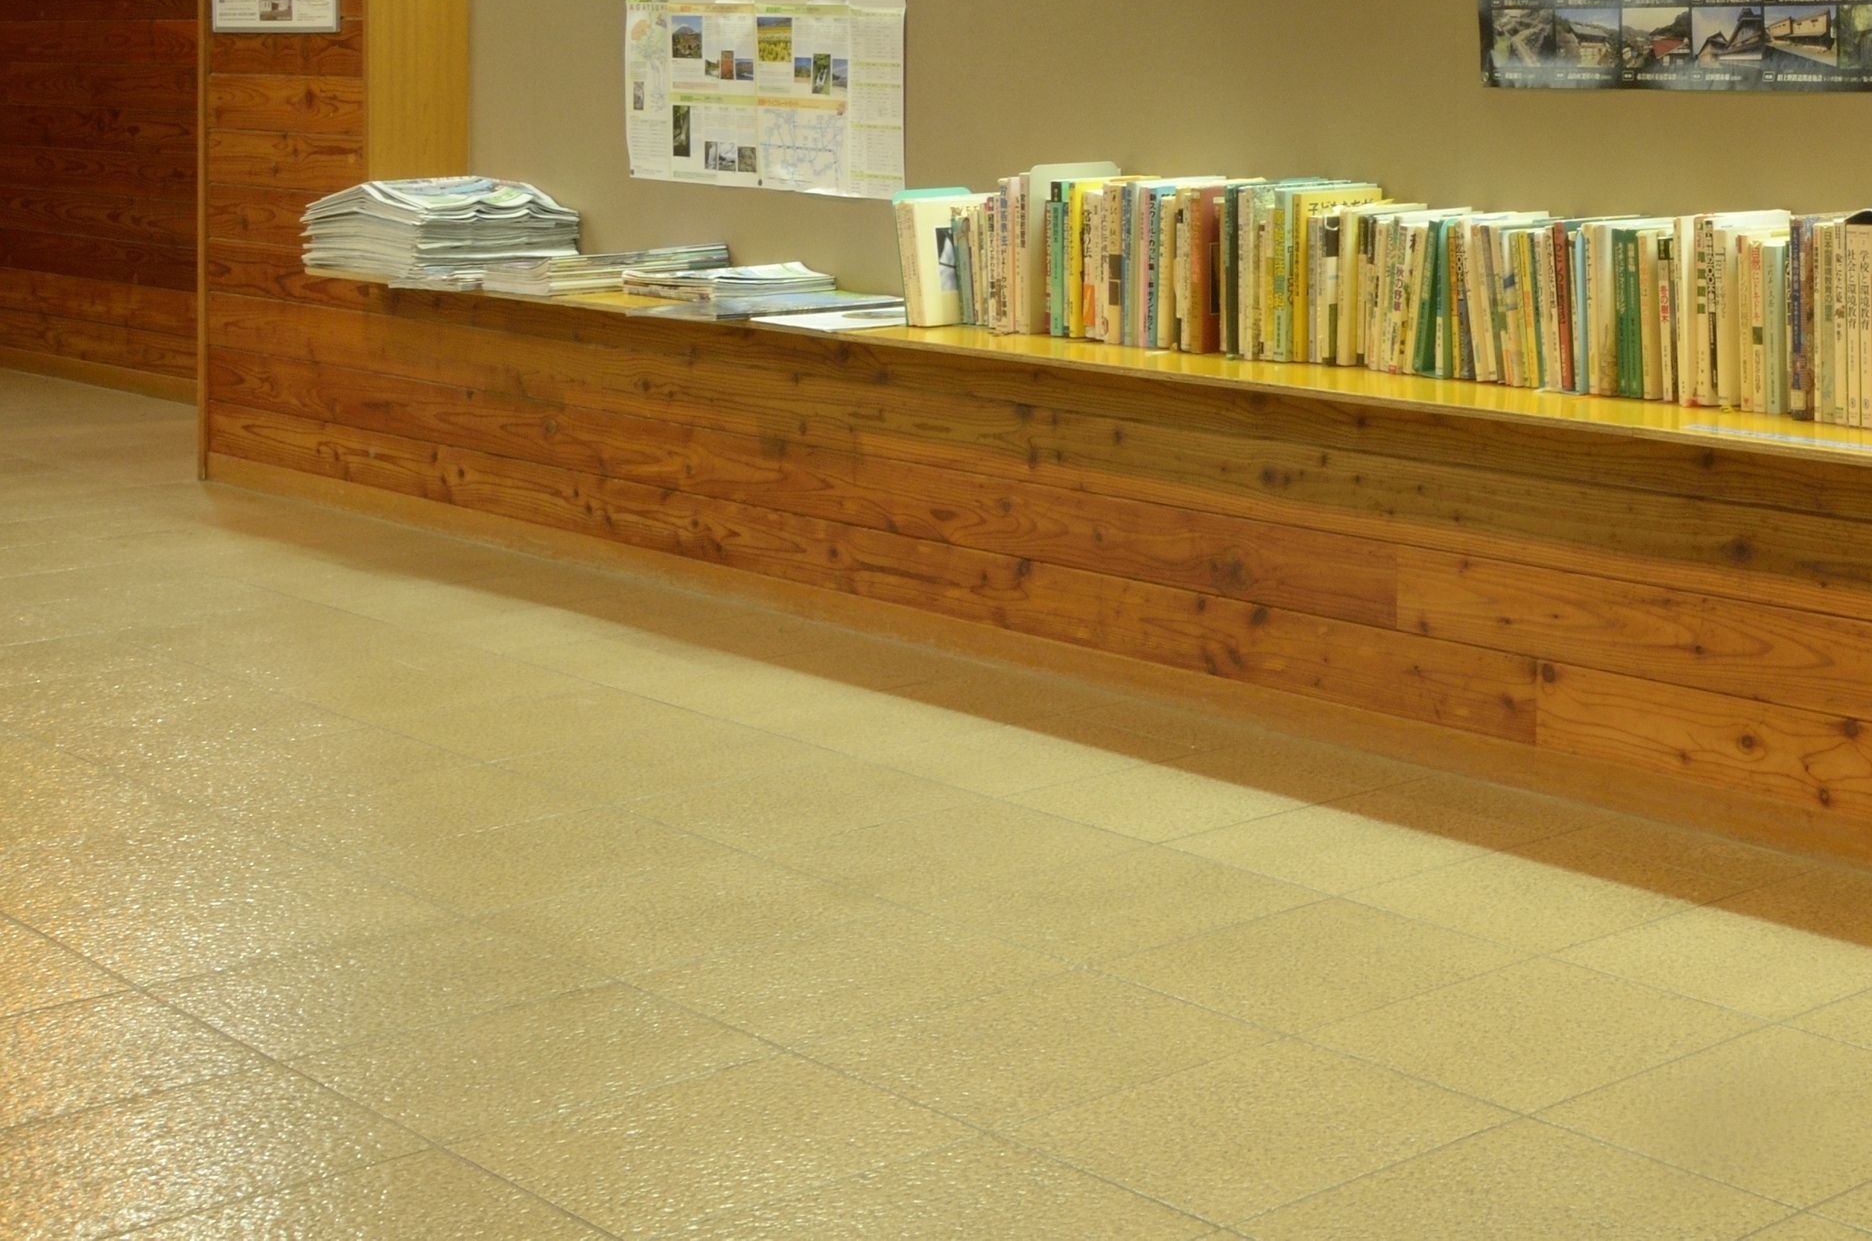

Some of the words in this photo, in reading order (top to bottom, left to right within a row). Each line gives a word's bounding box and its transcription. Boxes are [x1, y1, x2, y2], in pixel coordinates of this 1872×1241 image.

[1847, 249, 1857, 330] 社会と環境教育
[1860, 250, 1869, 330] 学校と環境教育
